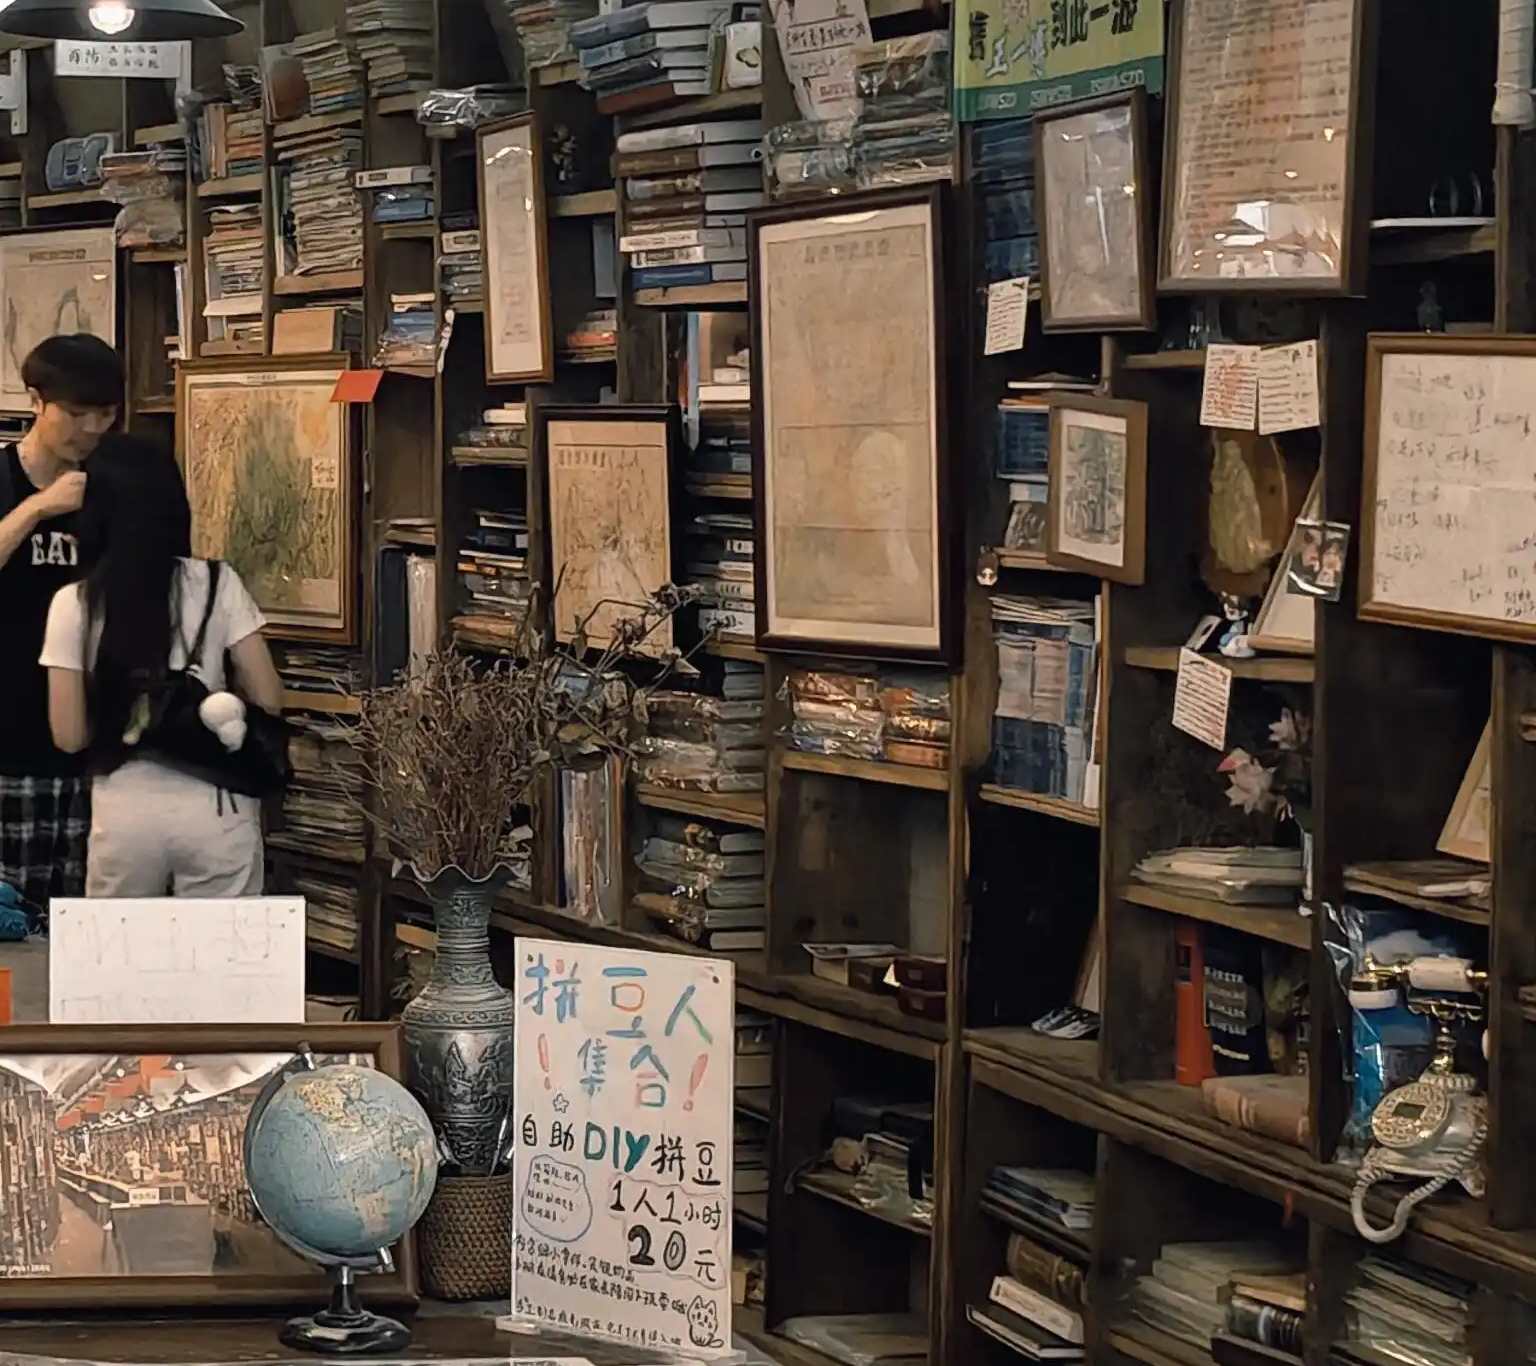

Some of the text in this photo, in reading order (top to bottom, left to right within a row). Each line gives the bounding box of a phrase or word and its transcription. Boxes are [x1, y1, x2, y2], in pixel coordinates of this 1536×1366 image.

[522, 952, 714, 1046] 拼豆人
[627, 1224, 718, 1285] 20元
